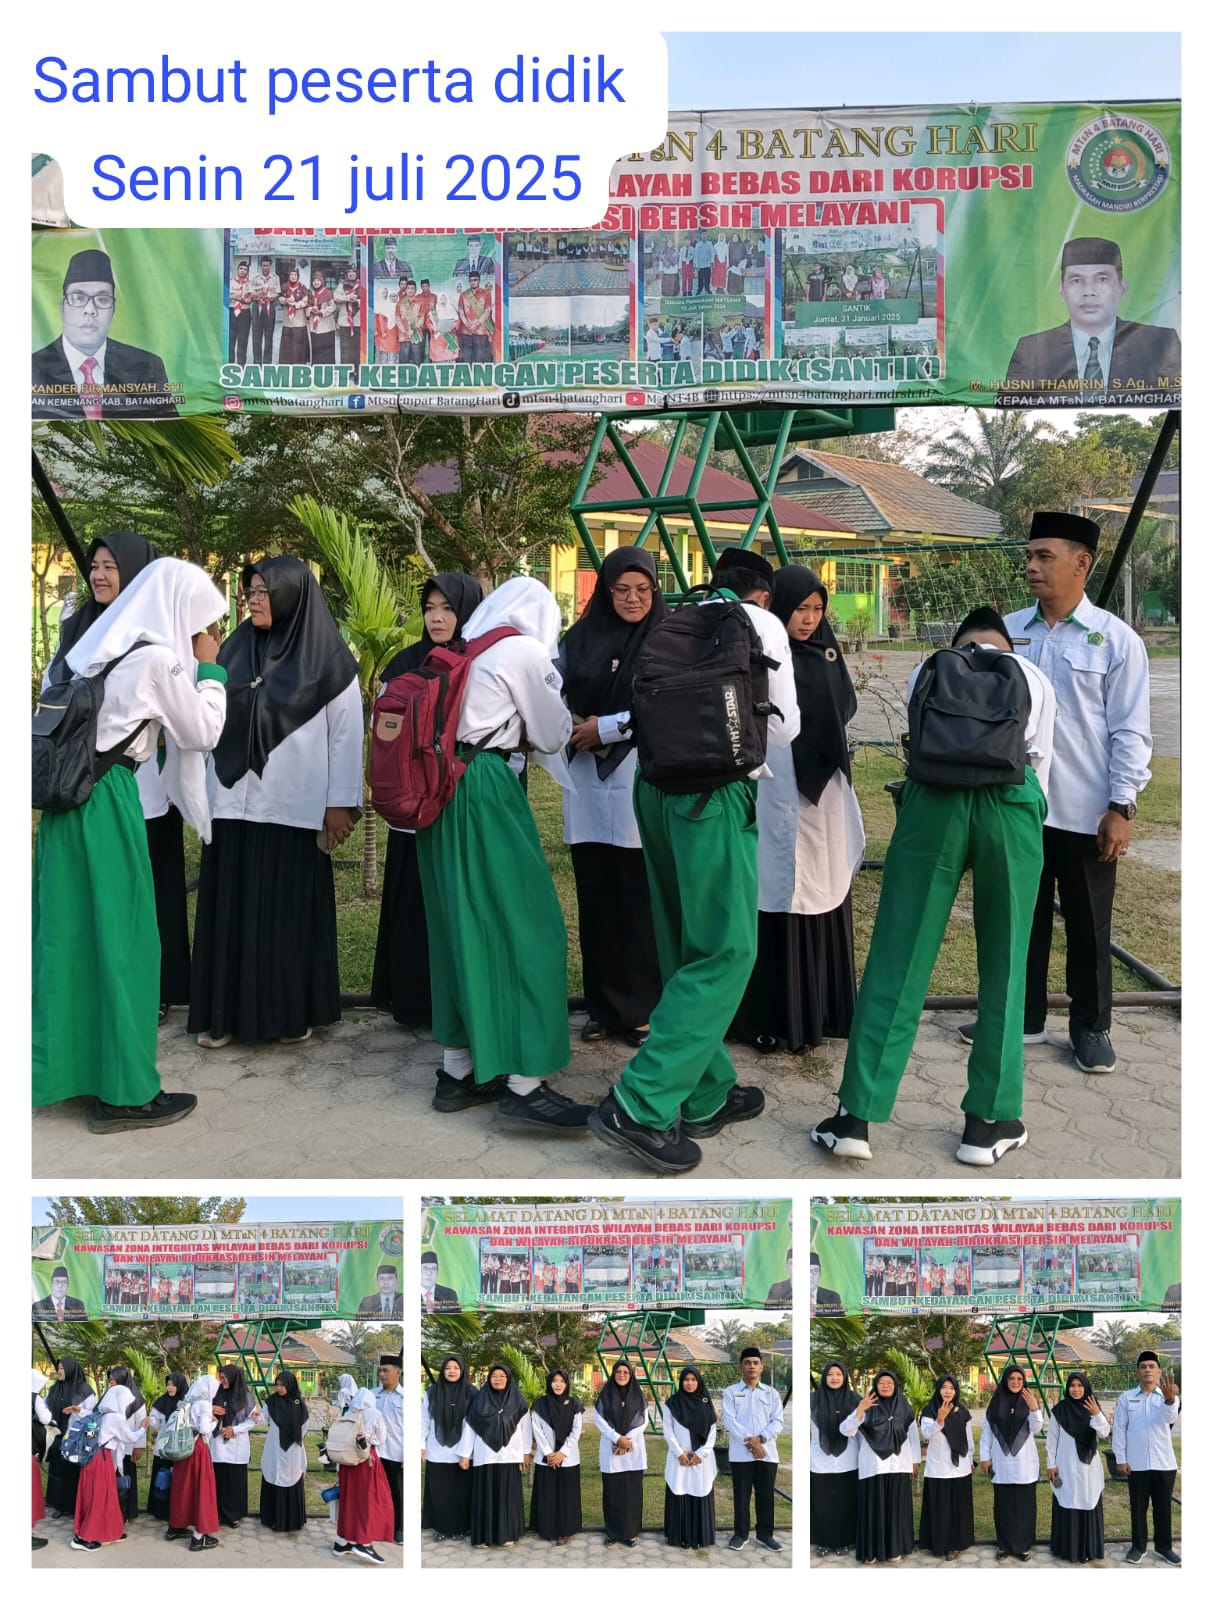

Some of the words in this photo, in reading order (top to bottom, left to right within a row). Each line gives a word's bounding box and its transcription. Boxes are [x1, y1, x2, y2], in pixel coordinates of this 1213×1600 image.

[706, 129, 728, 161] 4
[736, 125, 917, 160] BATANG
[927, 122, 1039, 155] HARI
[1071, 128, 1094, 155] MTsN
[1093, 123, 1101, 131] 4
[1102, 117, 1145, 133] BATANG
[1144, 129, 1165, 154] HARI
[701, 170, 801, 196] BEBAS
[809, 168, 884, 194] DARI
[893, 164, 1033, 192] KORUPSI
[640, 202, 752, 230] BERSIH
[760, 200, 911, 229] MELAYANI
[842, 304, 872, 312] SANTIK
[841, 314, 851, 322] 31
[853, 313, 881, 322] Januari
[881, 312, 901, 321] 2025
[221, 363, 353, 389] SAMBUT
[360, 361, 557, 388] KEDATANGAN
[564, 359, 696, 386] PESERTA
[701, 358, 793, 384] DIDIK
[797, 355, 942, 382] (SANTIK)
[990, 379, 1035, 390] HUSNI
[48, 397, 100, 407] KEMENANG
[101, 397, 123, 407] KAB.
[125, 396, 185, 406] BATANGHARI
[994, 396, 1046, 406] KEPALA
[1049, 395, 1084, 405] MTsN
[1087, 395, 1095, 404] 4
[444, 1210, 517, 1223] SELAMAT
[520, 1209, 588, 1222] DATANG
[668, 1207, 734, 1220] BATANG
[738, 1206, 779, 1218] HARI
[827, 1209, 903, 1222] SELAMAT
[907, 1208, 977, 1222] DATANG
[1060, 1206, 1128, 1219] BATANG
[1132, 1205, 1175, 1218] HARI
[444, 1225, 500, 1235] KAWASAN
[503, 1225, 532, 1235] ZONA
[534, 1224, 599, 1234] INTEGRITAS
[602, 1223, 652, 1233] WILAYAH
[655, 1223, 691, 1232] BEBAS
[694, 1222, 722, 1232] DARI
[725, 1221, 777, 1231] KORUPSI
[827, 1225, 886, 1235] KAWASAN
[888, 1225, 919, 1235] ZONA
[921, 1224, 990, 1235] INTEGRITAS
[992, 1223, 1044, 1233] WILAYAH
[1047, 1223, 1085, 1232] BEBAS
[1088, 1222, 1117, 1231] DARI
[1119, 1221, 1173, 1231] KORUPSI
[74, 1244, 122, 1253] KAWASAN
[125, 1244, 150, 1253] ZONA
[152, 1243, 210, 1252] INTEGRITAS
[212, 1242, 256, 1252] WILAYAH
[258, 1241, 292, 1251] BEBAS
[294, 1241, 319, 1250] DARI
[321, 1240, 368, 1249] KORUPSI
